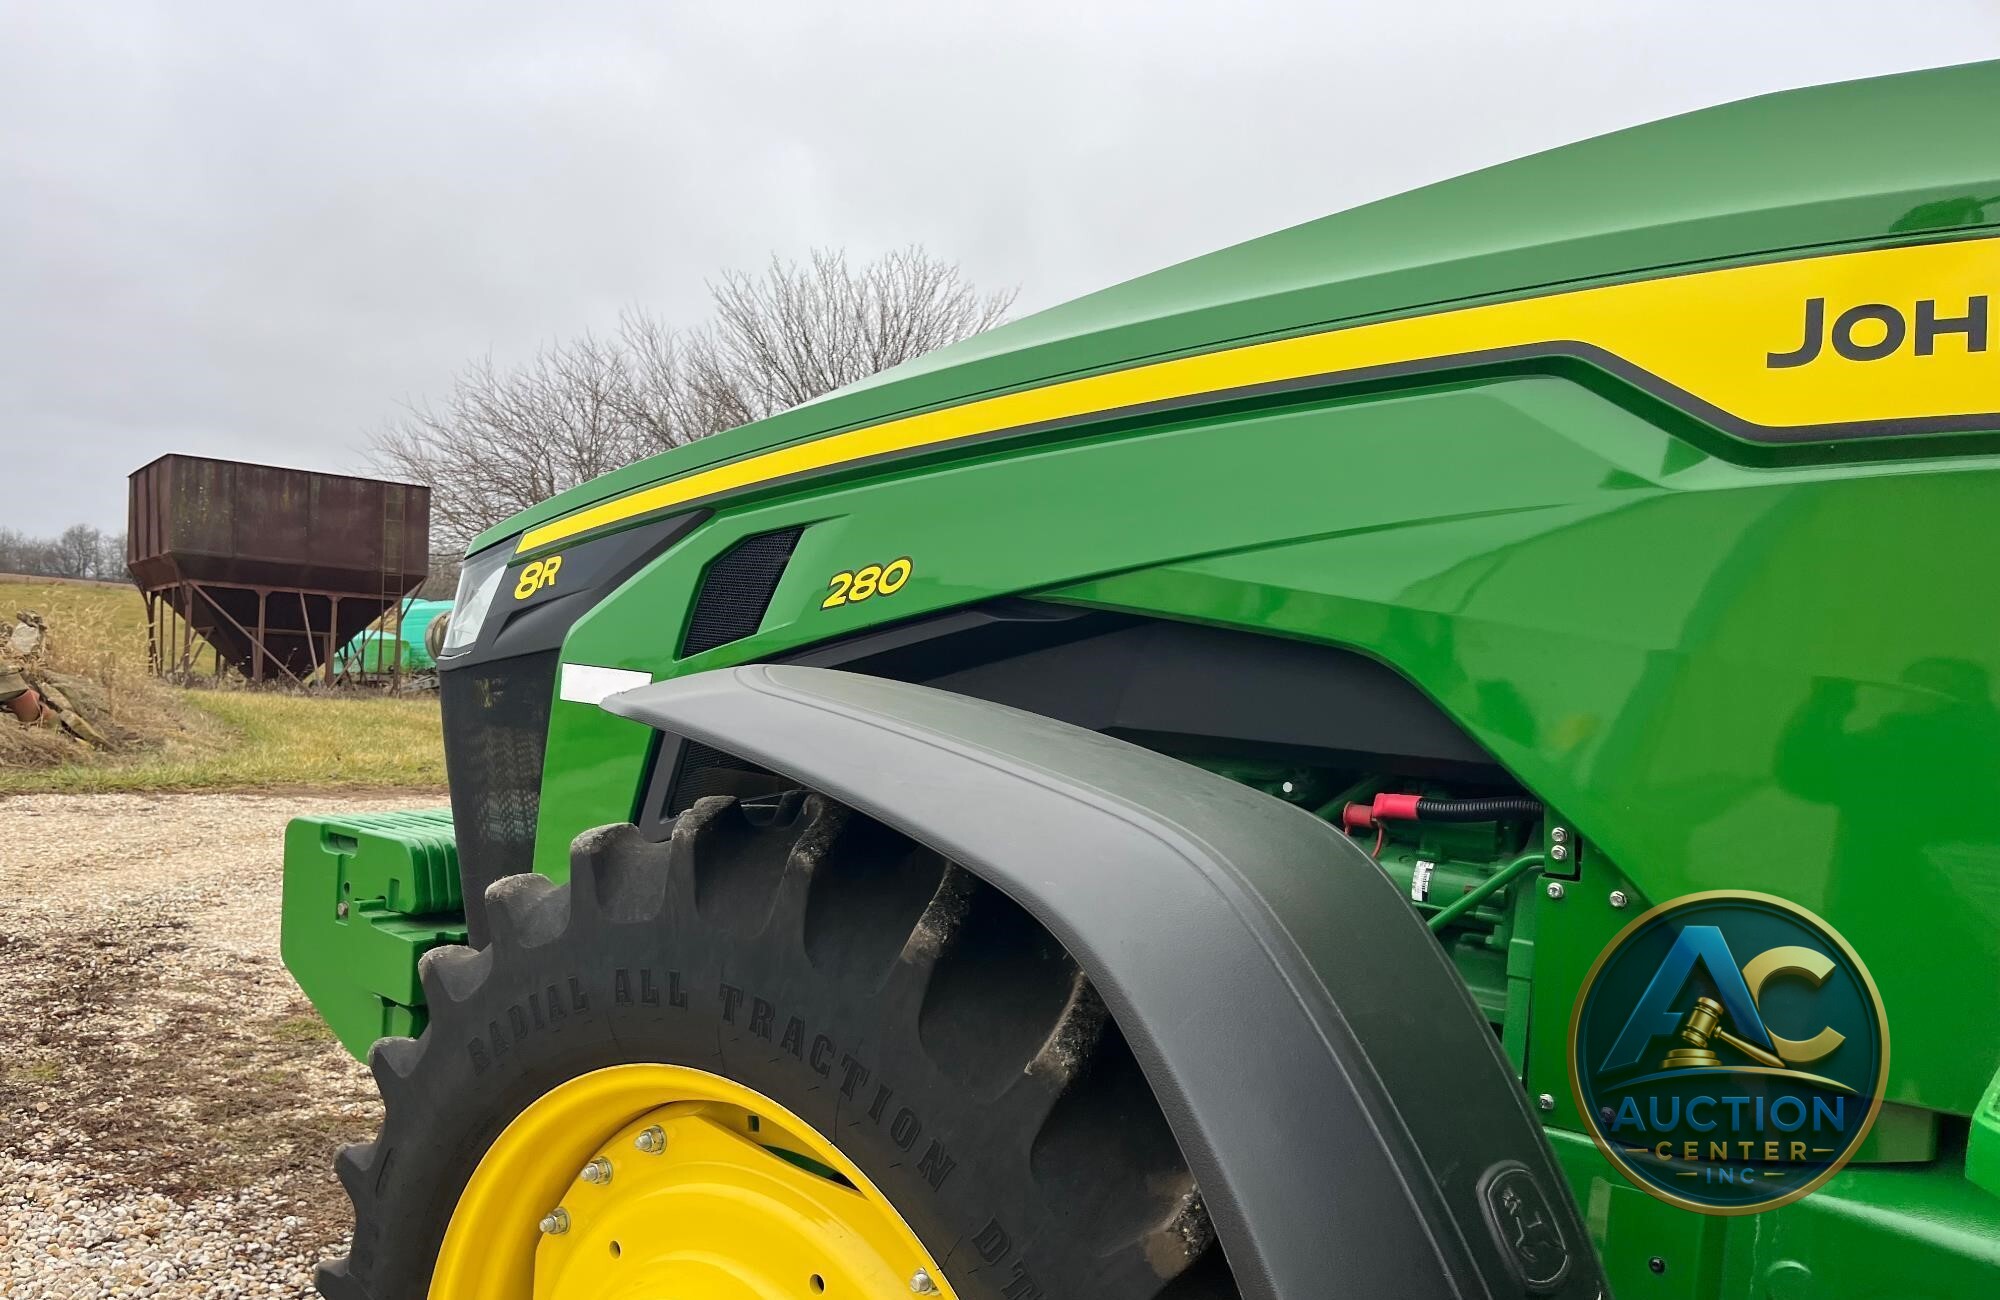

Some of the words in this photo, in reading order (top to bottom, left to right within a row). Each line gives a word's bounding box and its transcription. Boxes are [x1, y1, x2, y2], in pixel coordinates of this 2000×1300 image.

[514, 554, 562, 600] 8R
[821, 556, 914, 610] 280
[467, 975, 590, 1076] RADIAL
[615, 966, 689, 1009] ALL
[718, 983, 957, 1192] TRACTION
